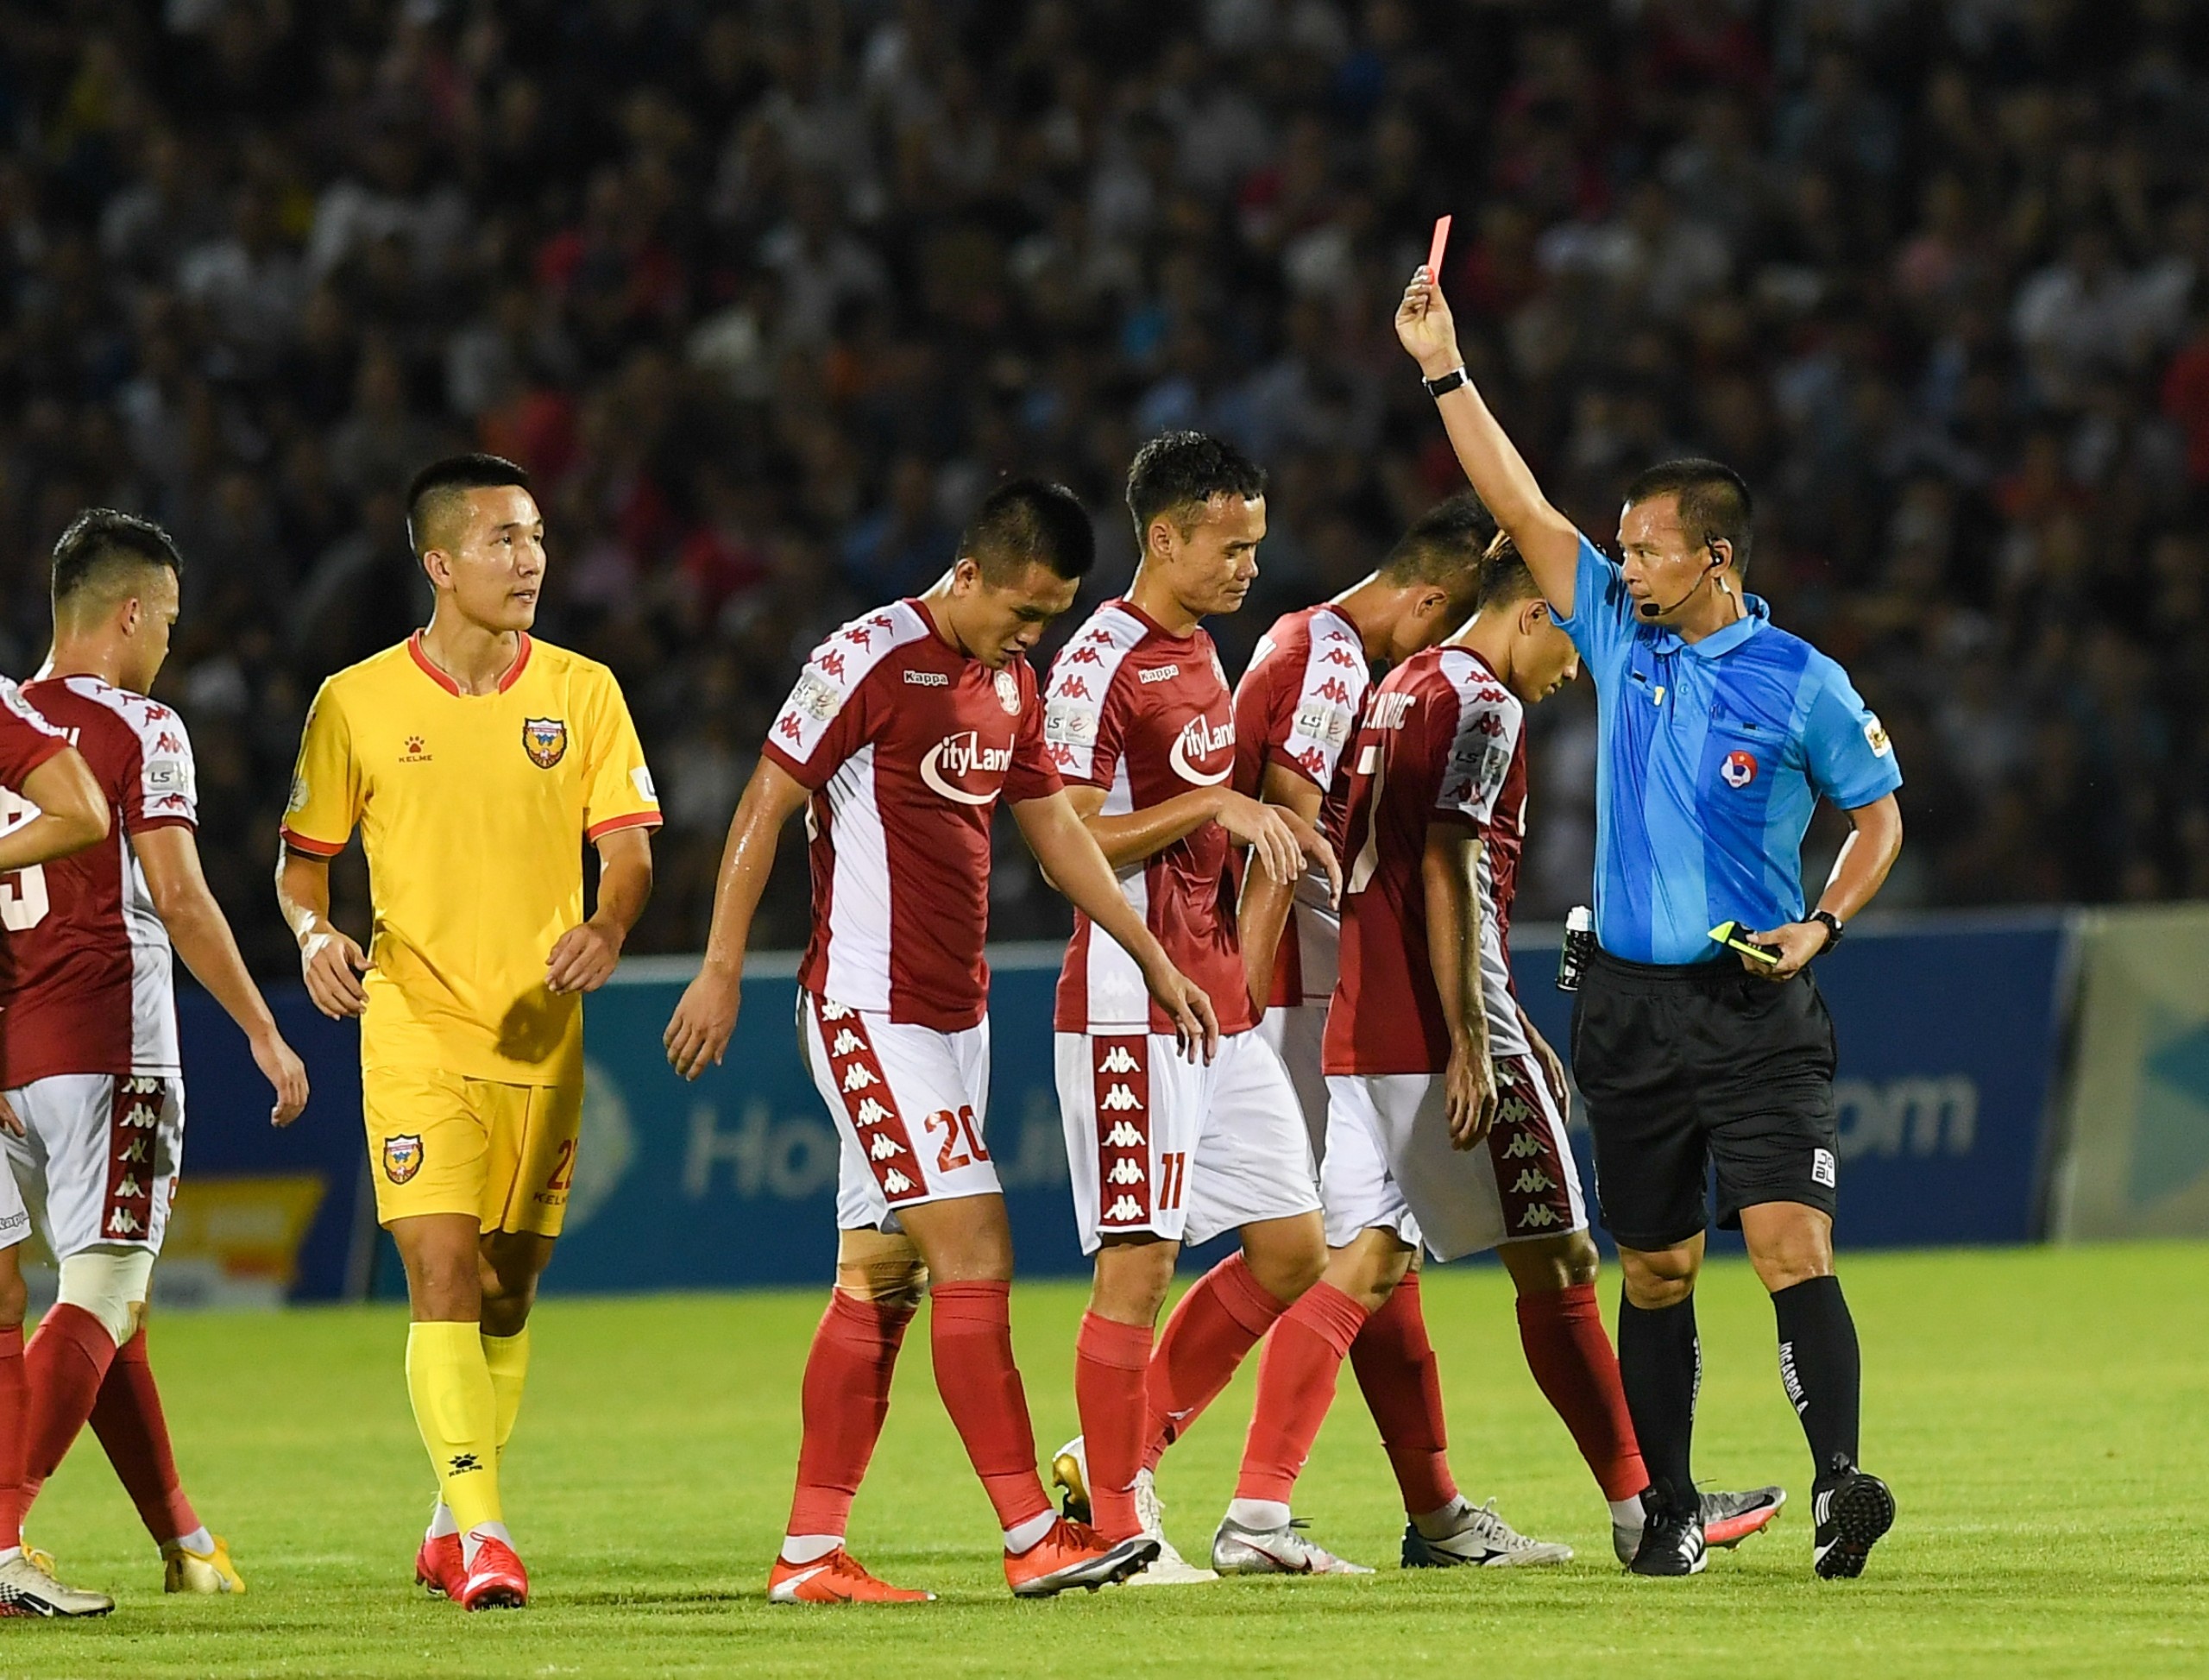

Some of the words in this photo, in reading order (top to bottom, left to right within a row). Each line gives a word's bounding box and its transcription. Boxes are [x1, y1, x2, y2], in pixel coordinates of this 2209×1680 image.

[905, 671, 947, 685] Kappa
[1140, 667, 1178, 682] Kappa
[399, 754, 432, 763] KELME
[1455, 751, 1479, 764] LS
[151, 771, 170, 783] LS
[1835, 1075, 1976, 1161] om
[924, 1104, 990, 1173] 20
[682, 1098, 840, 1199] Ho
[1158, 1152, 1186, 1210] 11
